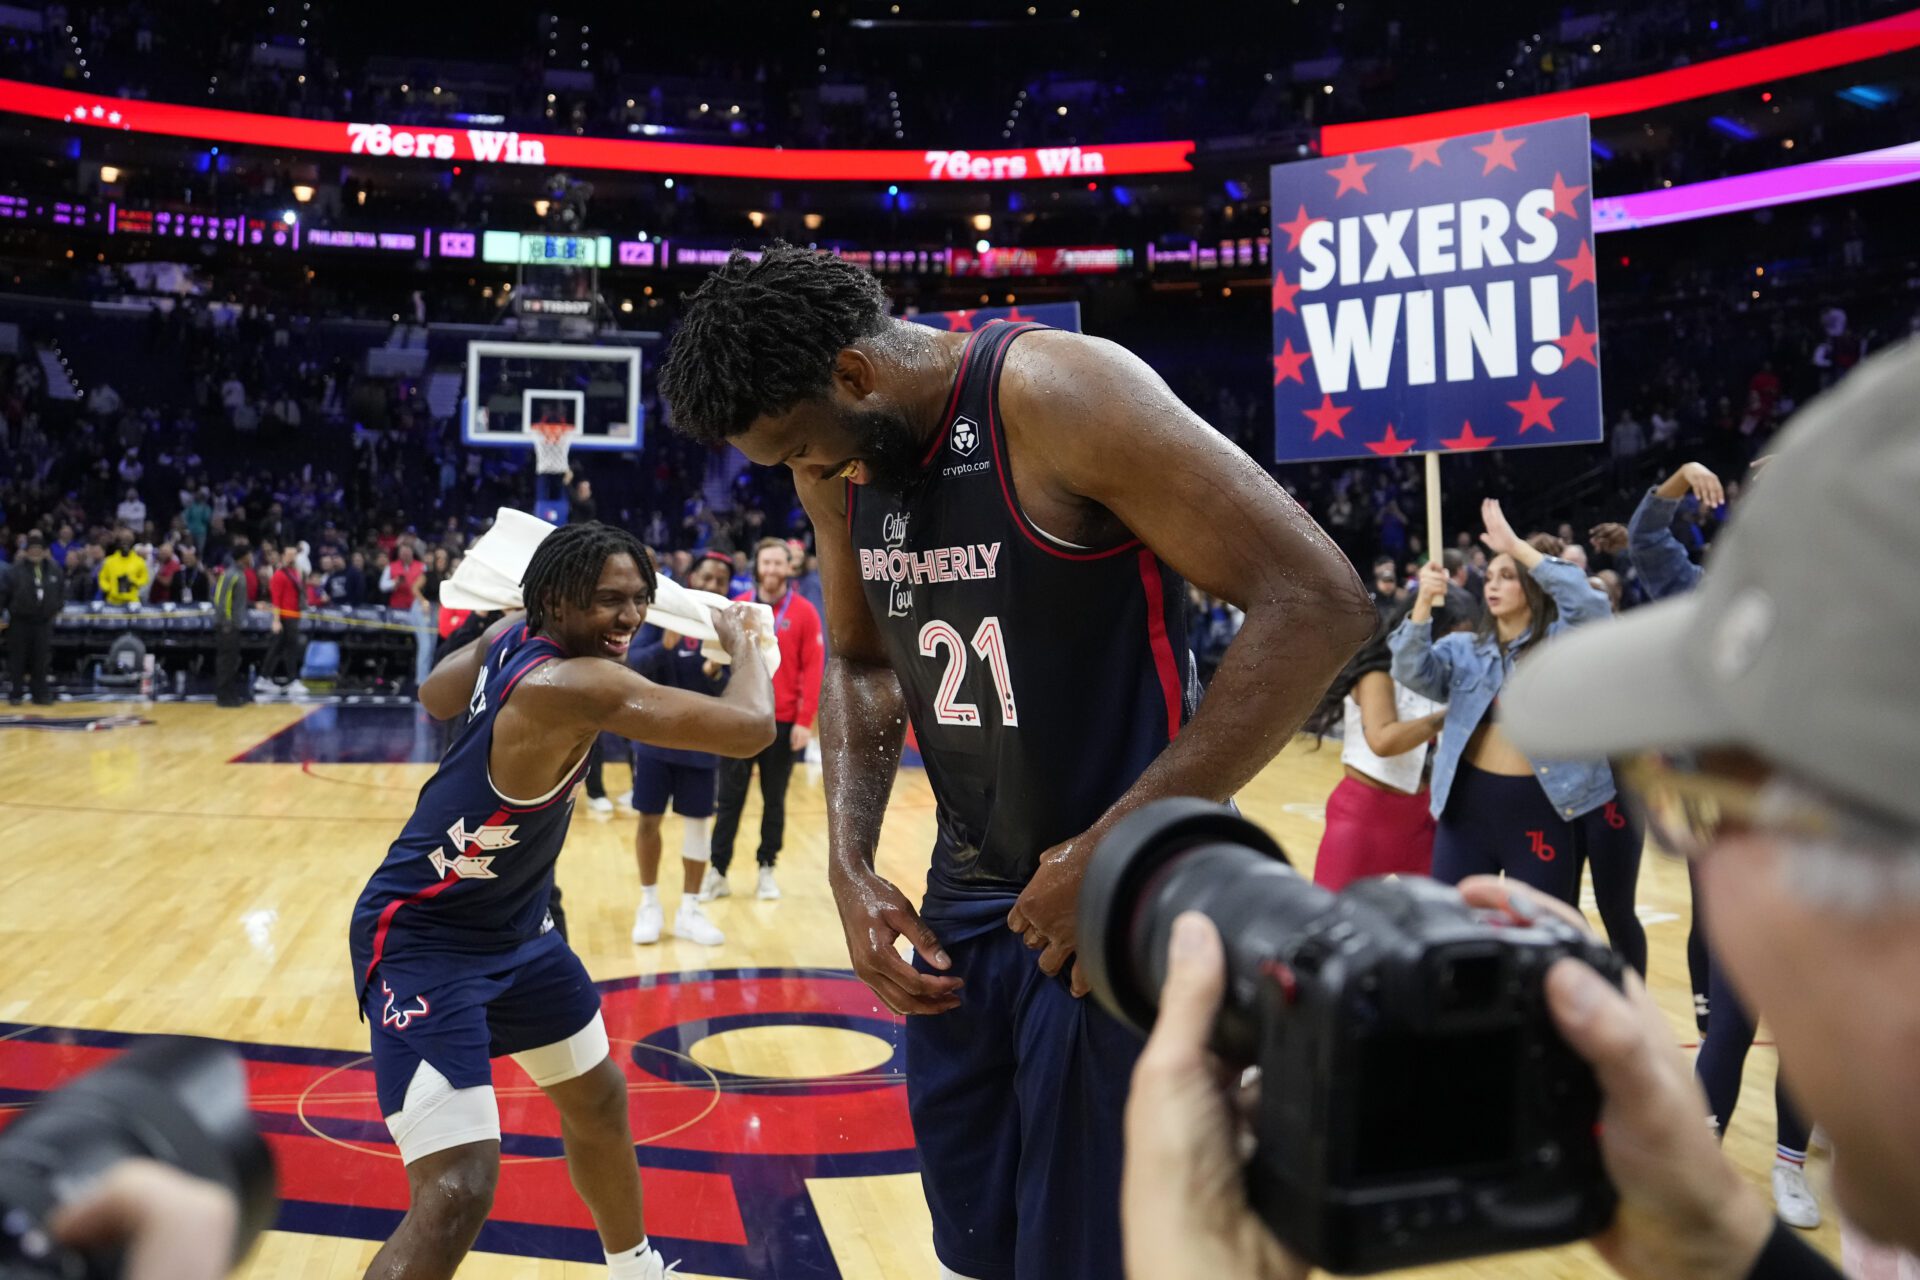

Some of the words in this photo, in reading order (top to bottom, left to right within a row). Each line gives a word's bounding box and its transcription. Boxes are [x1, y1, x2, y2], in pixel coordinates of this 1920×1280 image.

[347, 123, 455, 159] 76ers
[467, 130, 545, 164] Win
[925, 150, 1027, 179] 76ers
[1036, 147, 1105, 175] Win
[1299, 188, 1558, 291] SIXERS
[1301, 274, 1563, 394] WIN!
[942, 460, 990, 477] crypto.com
[860, 542, 1002, 585] BROTHERLY
[888, 582, 913, 618] Lov
[919, 616, 1018, 727] 21
[1525, 831, 1556, 862] 76
